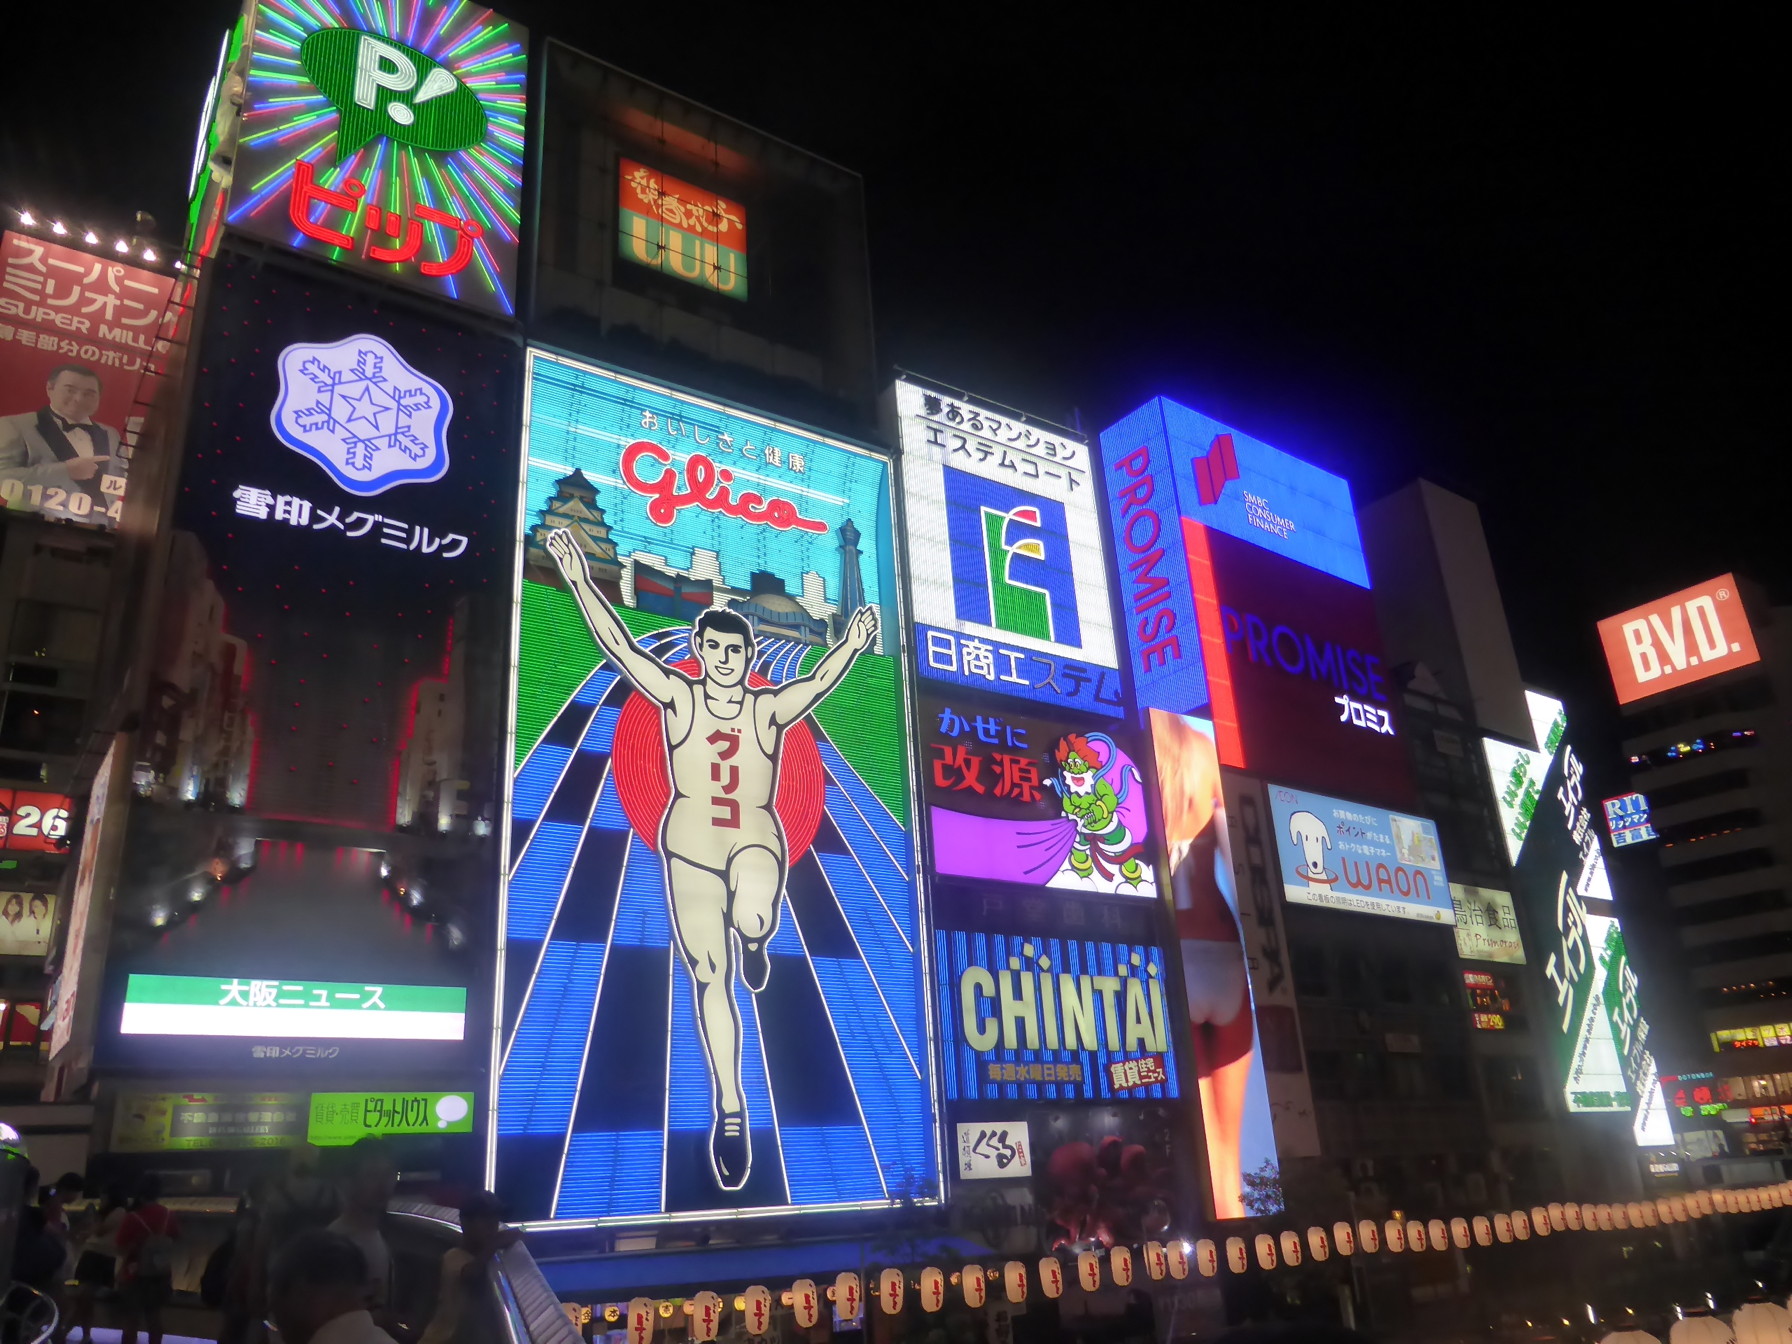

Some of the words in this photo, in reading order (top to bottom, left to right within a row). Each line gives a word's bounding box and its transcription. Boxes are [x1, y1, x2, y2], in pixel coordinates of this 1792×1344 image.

[289, 159, 485, 277] ピップ
[7, 238, 159, 294] スーパー
[0, 298, 91, 334] SUPER
[640, 409, 806, 473] おいしさと健康
[922, 393, 1077, 460] 夢あるマンション
[926, 425, 1081, 492] エステムコート
[619, 439, 830, 535] Glico
[1243, 490, 1270, 510] SMBC
[231, 484, 469, 558] 雪印メグミルク
[1245, 502, 1297, 533] CONSUMER
[1247, 513, 1289, 540] FINANCE
[1113, 445, 1182, 674] PROMISE
[1221, 605, 1388, 703] PROMISE
[1622, 594, 1742, 684] B.V.D.
[937, 707, 1029, 749] かぜに
[1334, 694, 1396, 736] プロミス
[705, 727, 742, 830] グリコ
[931, 742, 1044, 803] 改源
[13, 805, 69, 839] 26
[1341, 856, 1432, 901] WAON
[218, 978, 386, 1009] 大阪ニュース
[252, 1045, 340, 1059] 雪印メグミルク
[988, 1063, 1083, 1081] 毎週水曜日発売
[1110, 1061, 1142, 1089] 賃貸
[1138, 1058, 1155, 1072] 住宅
[1140, 1068, 1166, 1084] ニュース
[362, 1096, 430, 1129] ピタットハウス
[971, 1129, 1017, 1169] くくる
